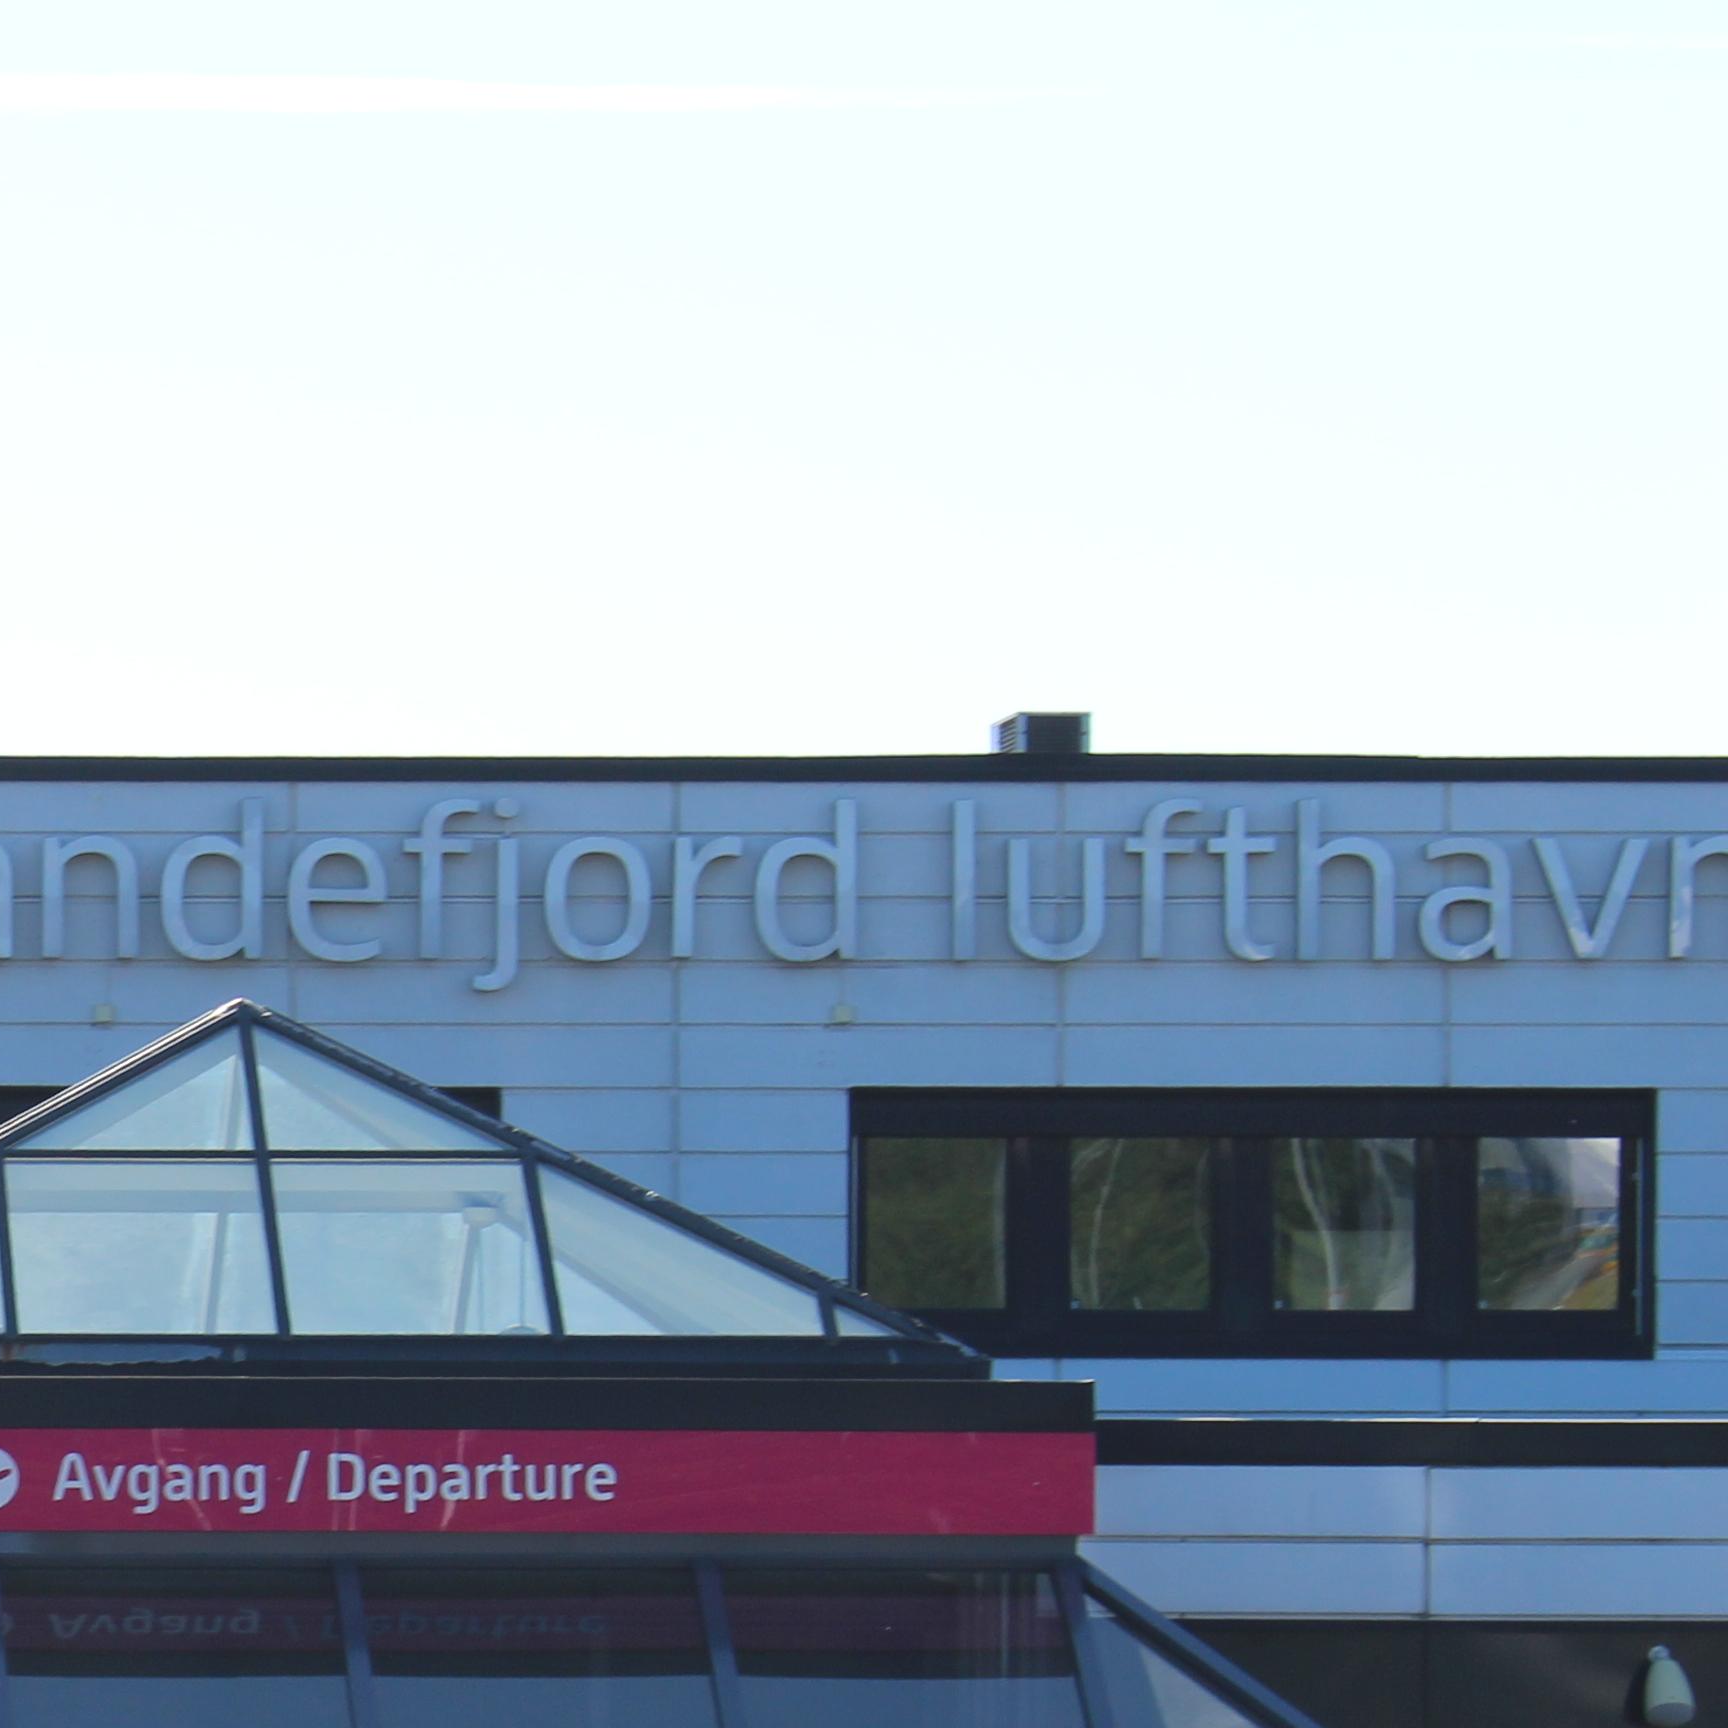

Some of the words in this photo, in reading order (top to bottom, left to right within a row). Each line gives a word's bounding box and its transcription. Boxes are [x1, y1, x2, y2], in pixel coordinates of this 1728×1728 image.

[52, 1452, 268, 1514] Avgang
[286, 1450, 310, 1503] /
[326, 1453, 618, 1513] Departure
